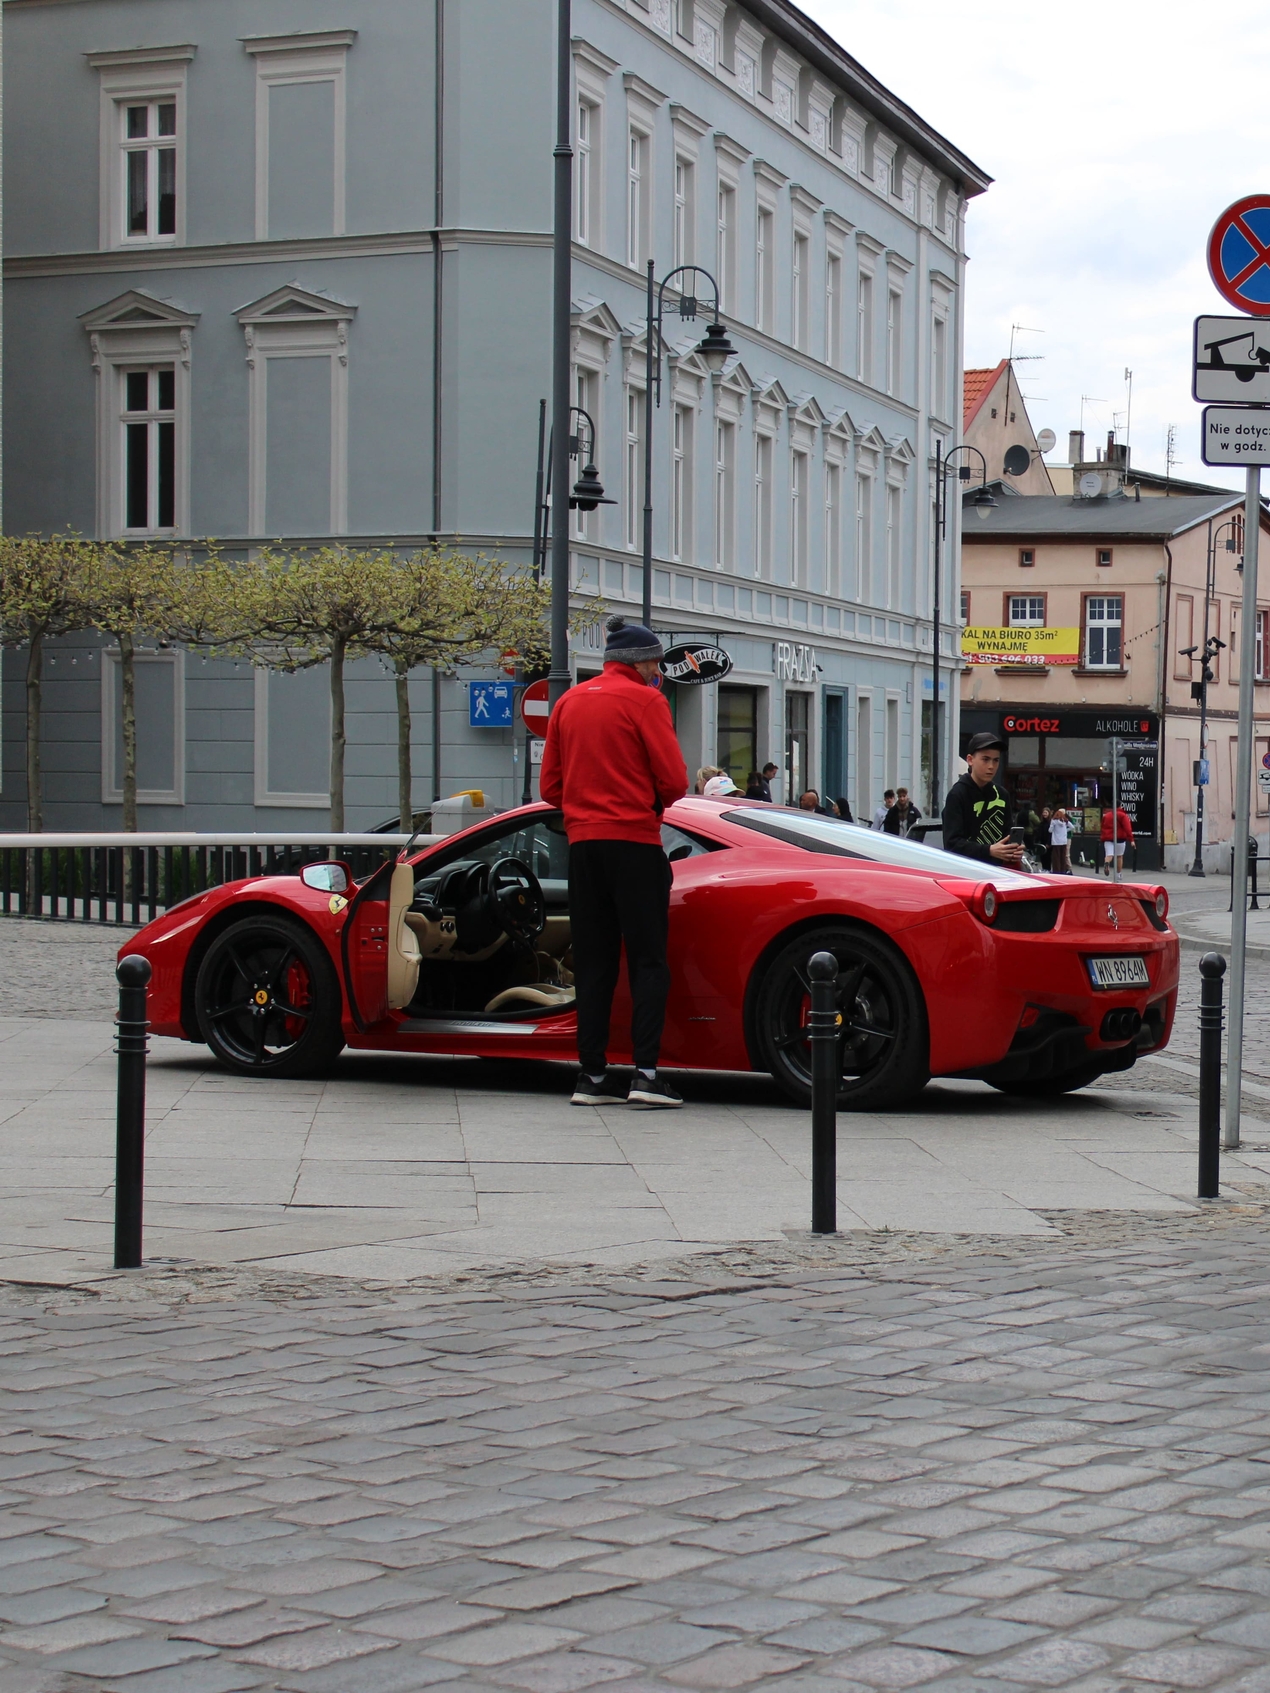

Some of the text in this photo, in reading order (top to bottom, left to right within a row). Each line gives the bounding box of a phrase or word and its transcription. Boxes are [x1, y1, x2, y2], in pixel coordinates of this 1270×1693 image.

[1210, 423, 1230, 435] Nie
[1220, 442, 1230, 450] w
[1234, 441, 1267, 454] godz.
[961, 629, 979, 639] KAL
[982, 629, 996, 639] NA
[999, 629, 1032, 640] BIURO
[977, 641, 1028, 653] WYNAJMĘ
[1024, 655, 1045, 665] 033
[673, 661, 690, 676] POD
[1003, 715, 1060, 732] Cortez
[1095, 720, 1138, 732] ALKOHOLE
[1139, 757, 1154, 767] 24H
[1121, 771, 1144, 780] WÓDKA
[1121, 782, 1137, 791] WINO
[1121, 792, 1144, 801] WHISKY
[1120, 802, 1136, 812] PIWO
[1095, 960, 1147, 982] WN 8964M
